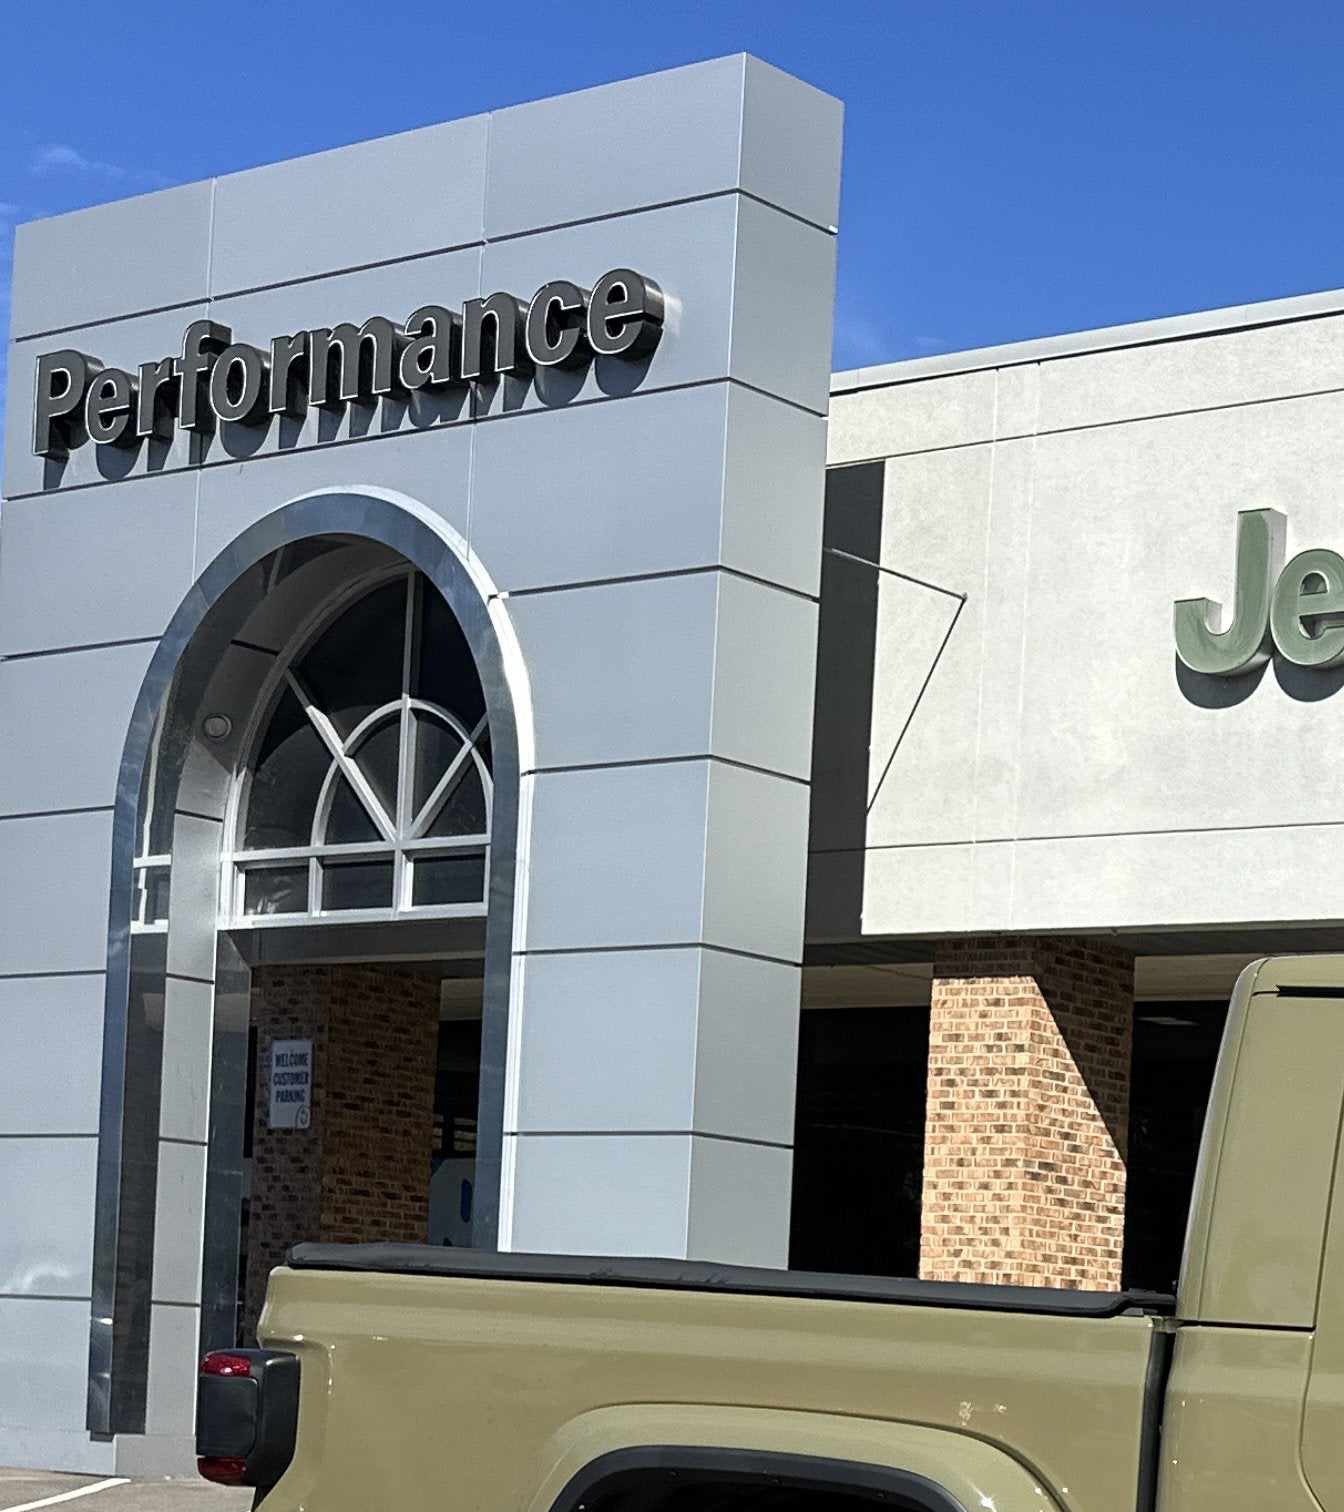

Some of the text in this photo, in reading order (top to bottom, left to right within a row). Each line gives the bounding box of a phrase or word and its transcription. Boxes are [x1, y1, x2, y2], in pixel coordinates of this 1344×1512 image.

[32, 267, 664, 456] Performance
[275, 1052, 308, 1067] WELCOME
[273, 1071, 309, 1087] CUSTOMER
[275, 1089, 305, 1103] PARKING
